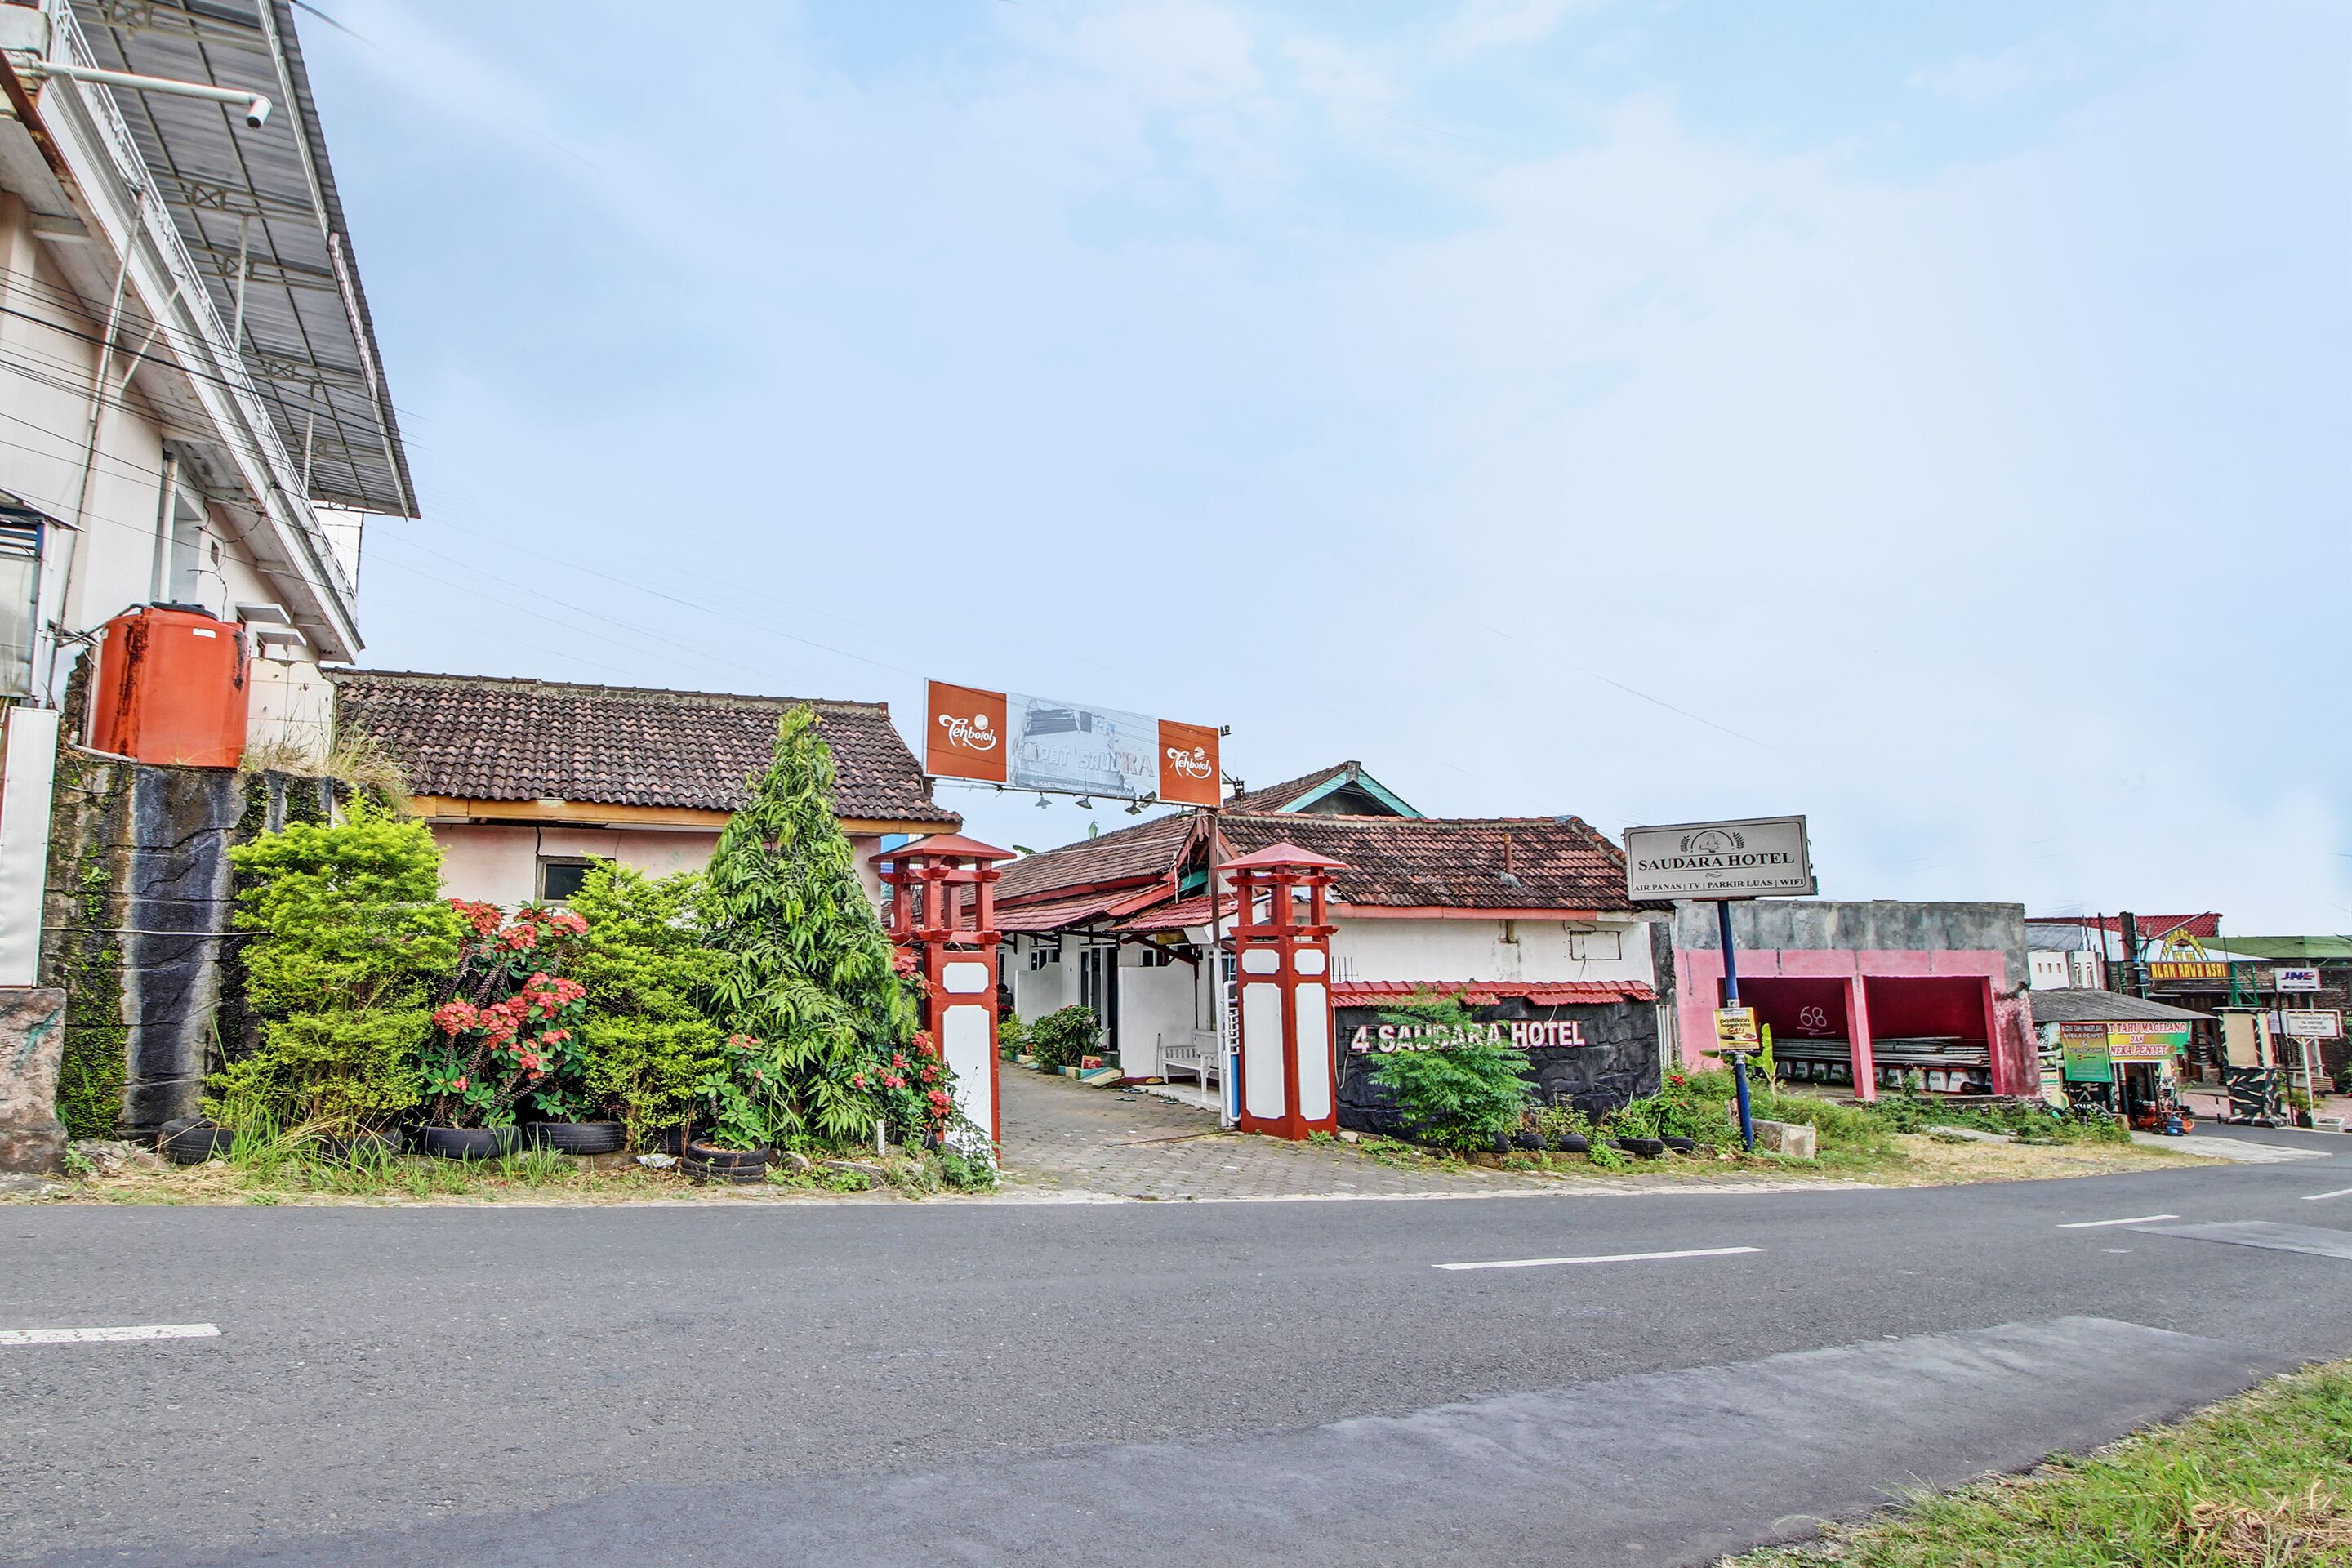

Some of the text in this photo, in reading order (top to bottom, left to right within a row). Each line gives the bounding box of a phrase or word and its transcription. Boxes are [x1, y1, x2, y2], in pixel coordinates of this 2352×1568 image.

[1638, 852, 1795, 871] SAUDARA HOTEL
[1708, 880, 1744, 889] PARKIR
[1747, 879, 1773, 887] LUAS
[1780, 878, 1804, 886] WIFI
[2178, 963, 2203, 978] RAWA
[2205, 963, 2226, 978] ASRI
[2280, 972, 2314, 980] JNE
[1800, 1005, 1828, 1027] 68
[2117, 1022, 2140, 1033] TAHU
[2141, 1022, 2186, 1033] MAGELANG
[1351, 1024, 1370, 1054] 4
[1511, 1021, 1586, 1047] HOTEL
[2134, 1045, 2167, 1054] PENYET
